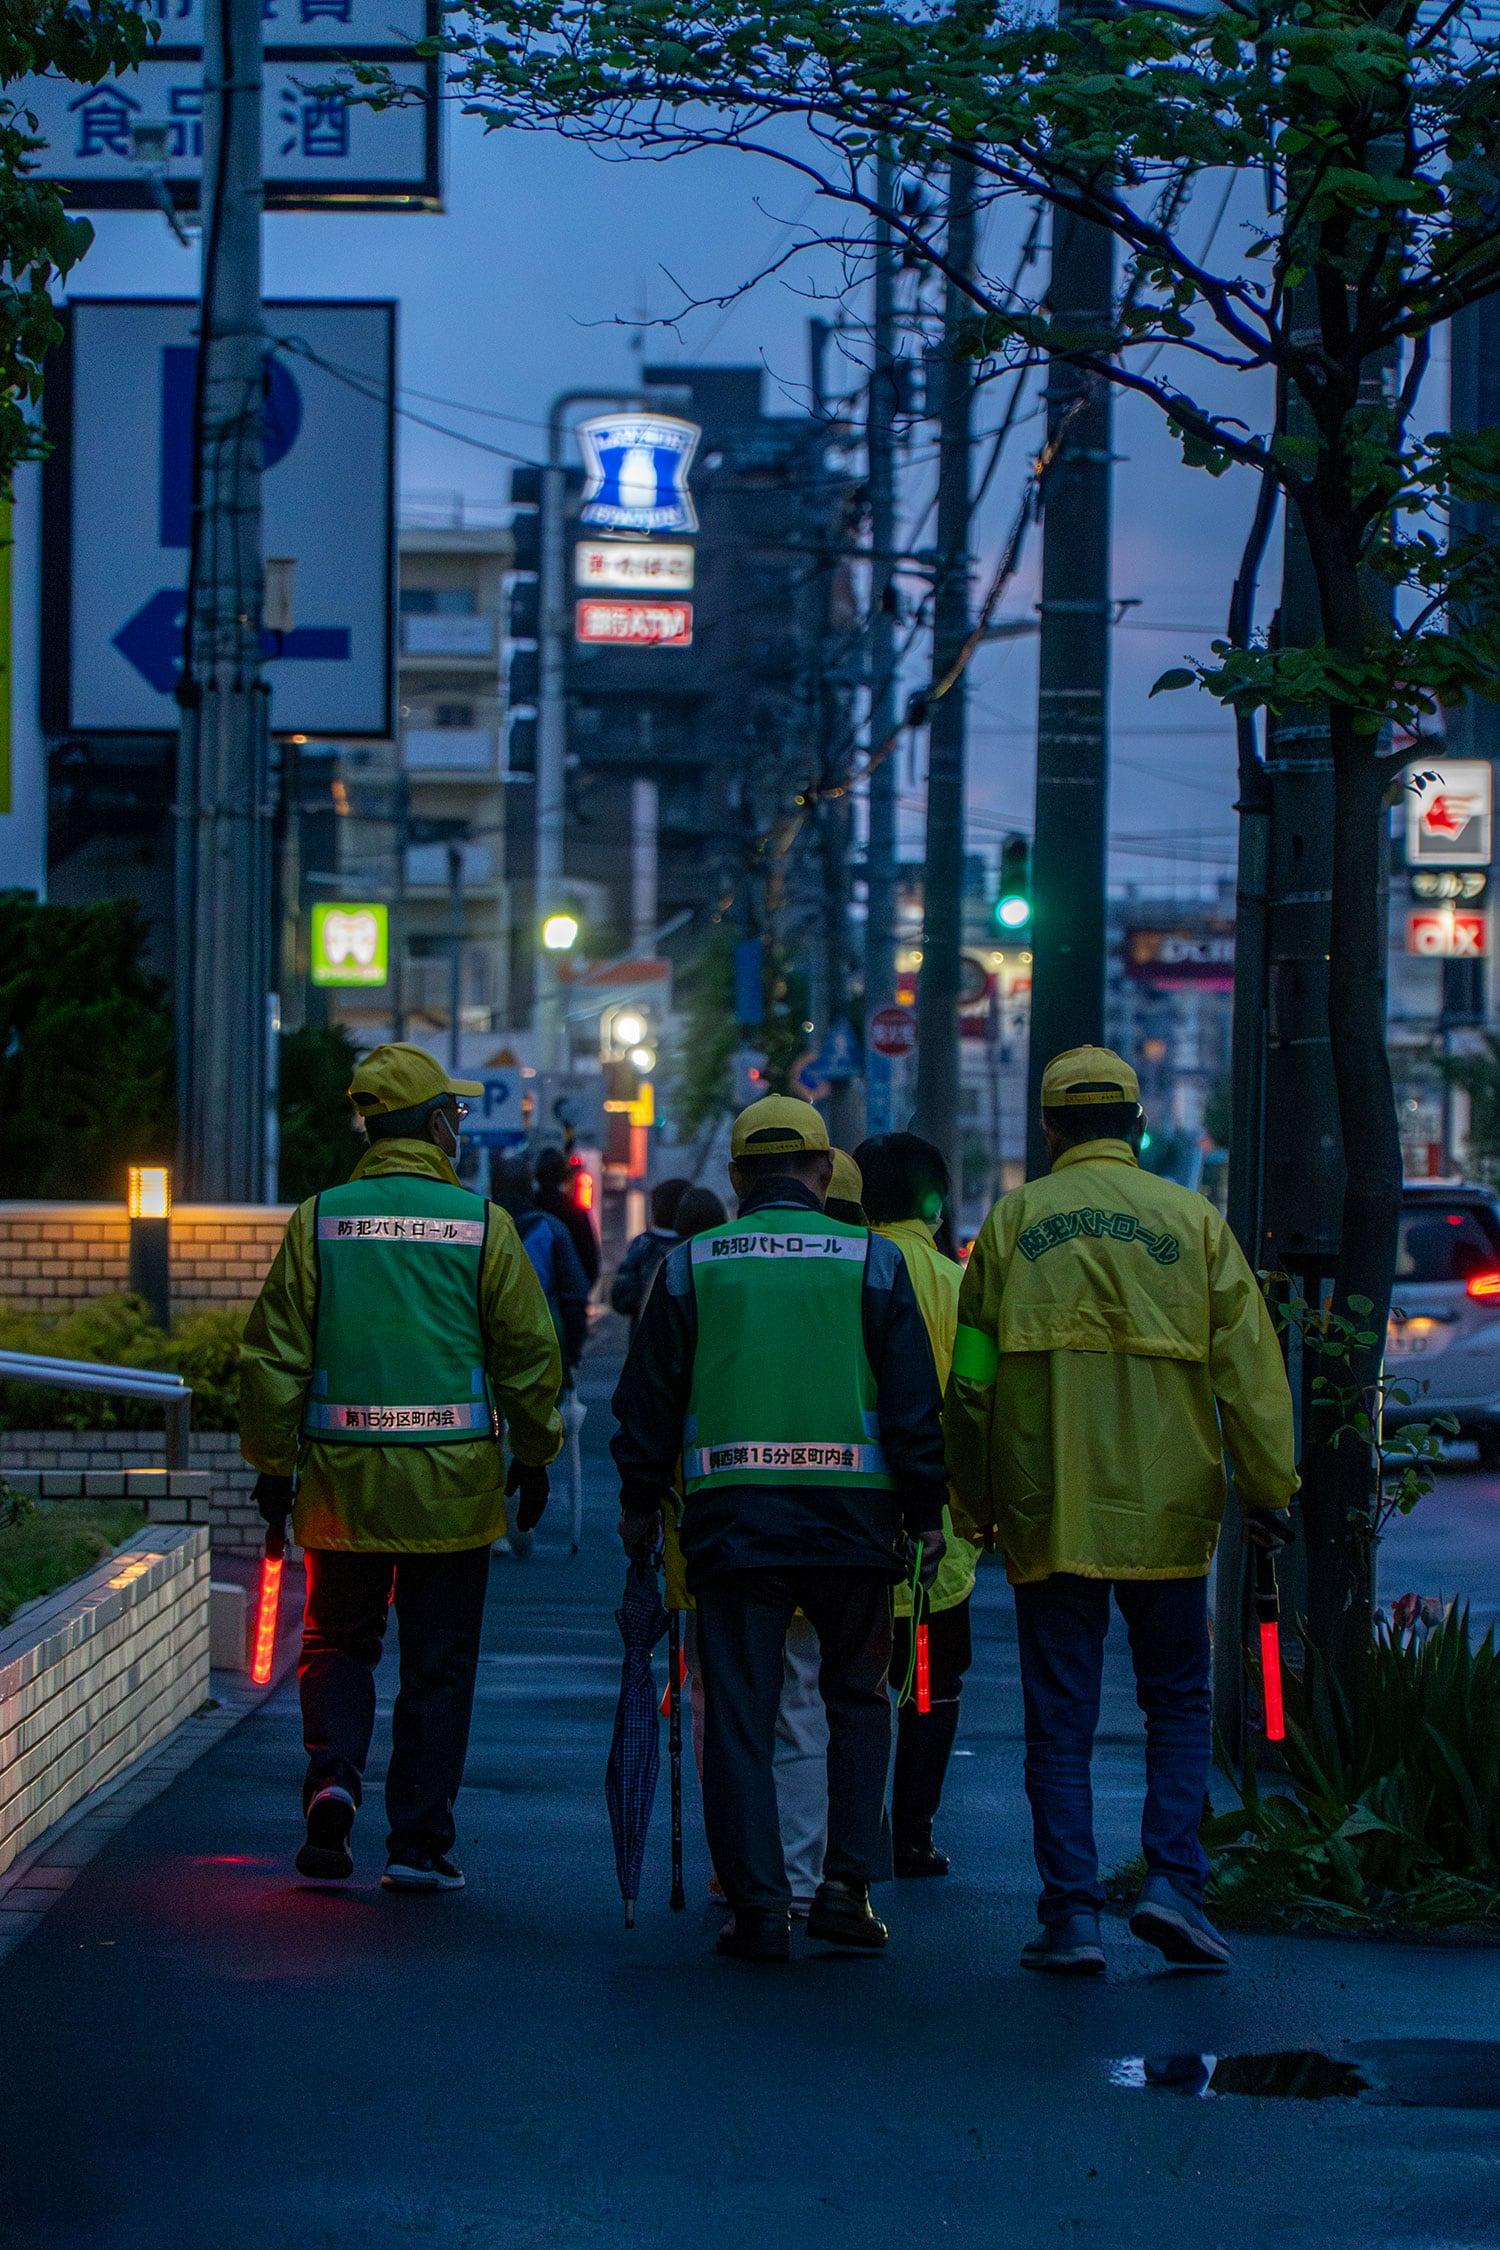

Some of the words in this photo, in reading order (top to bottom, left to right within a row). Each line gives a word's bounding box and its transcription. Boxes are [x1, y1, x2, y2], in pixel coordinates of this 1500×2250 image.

[484, 1080, 509, 1118] P
[712, 1236, 842, 1256] 防犯パトロール
[1018, 1208, 1179, 1264] 防犯パトロール
[345, 1409, 455, 1427] 第15分区町内会
